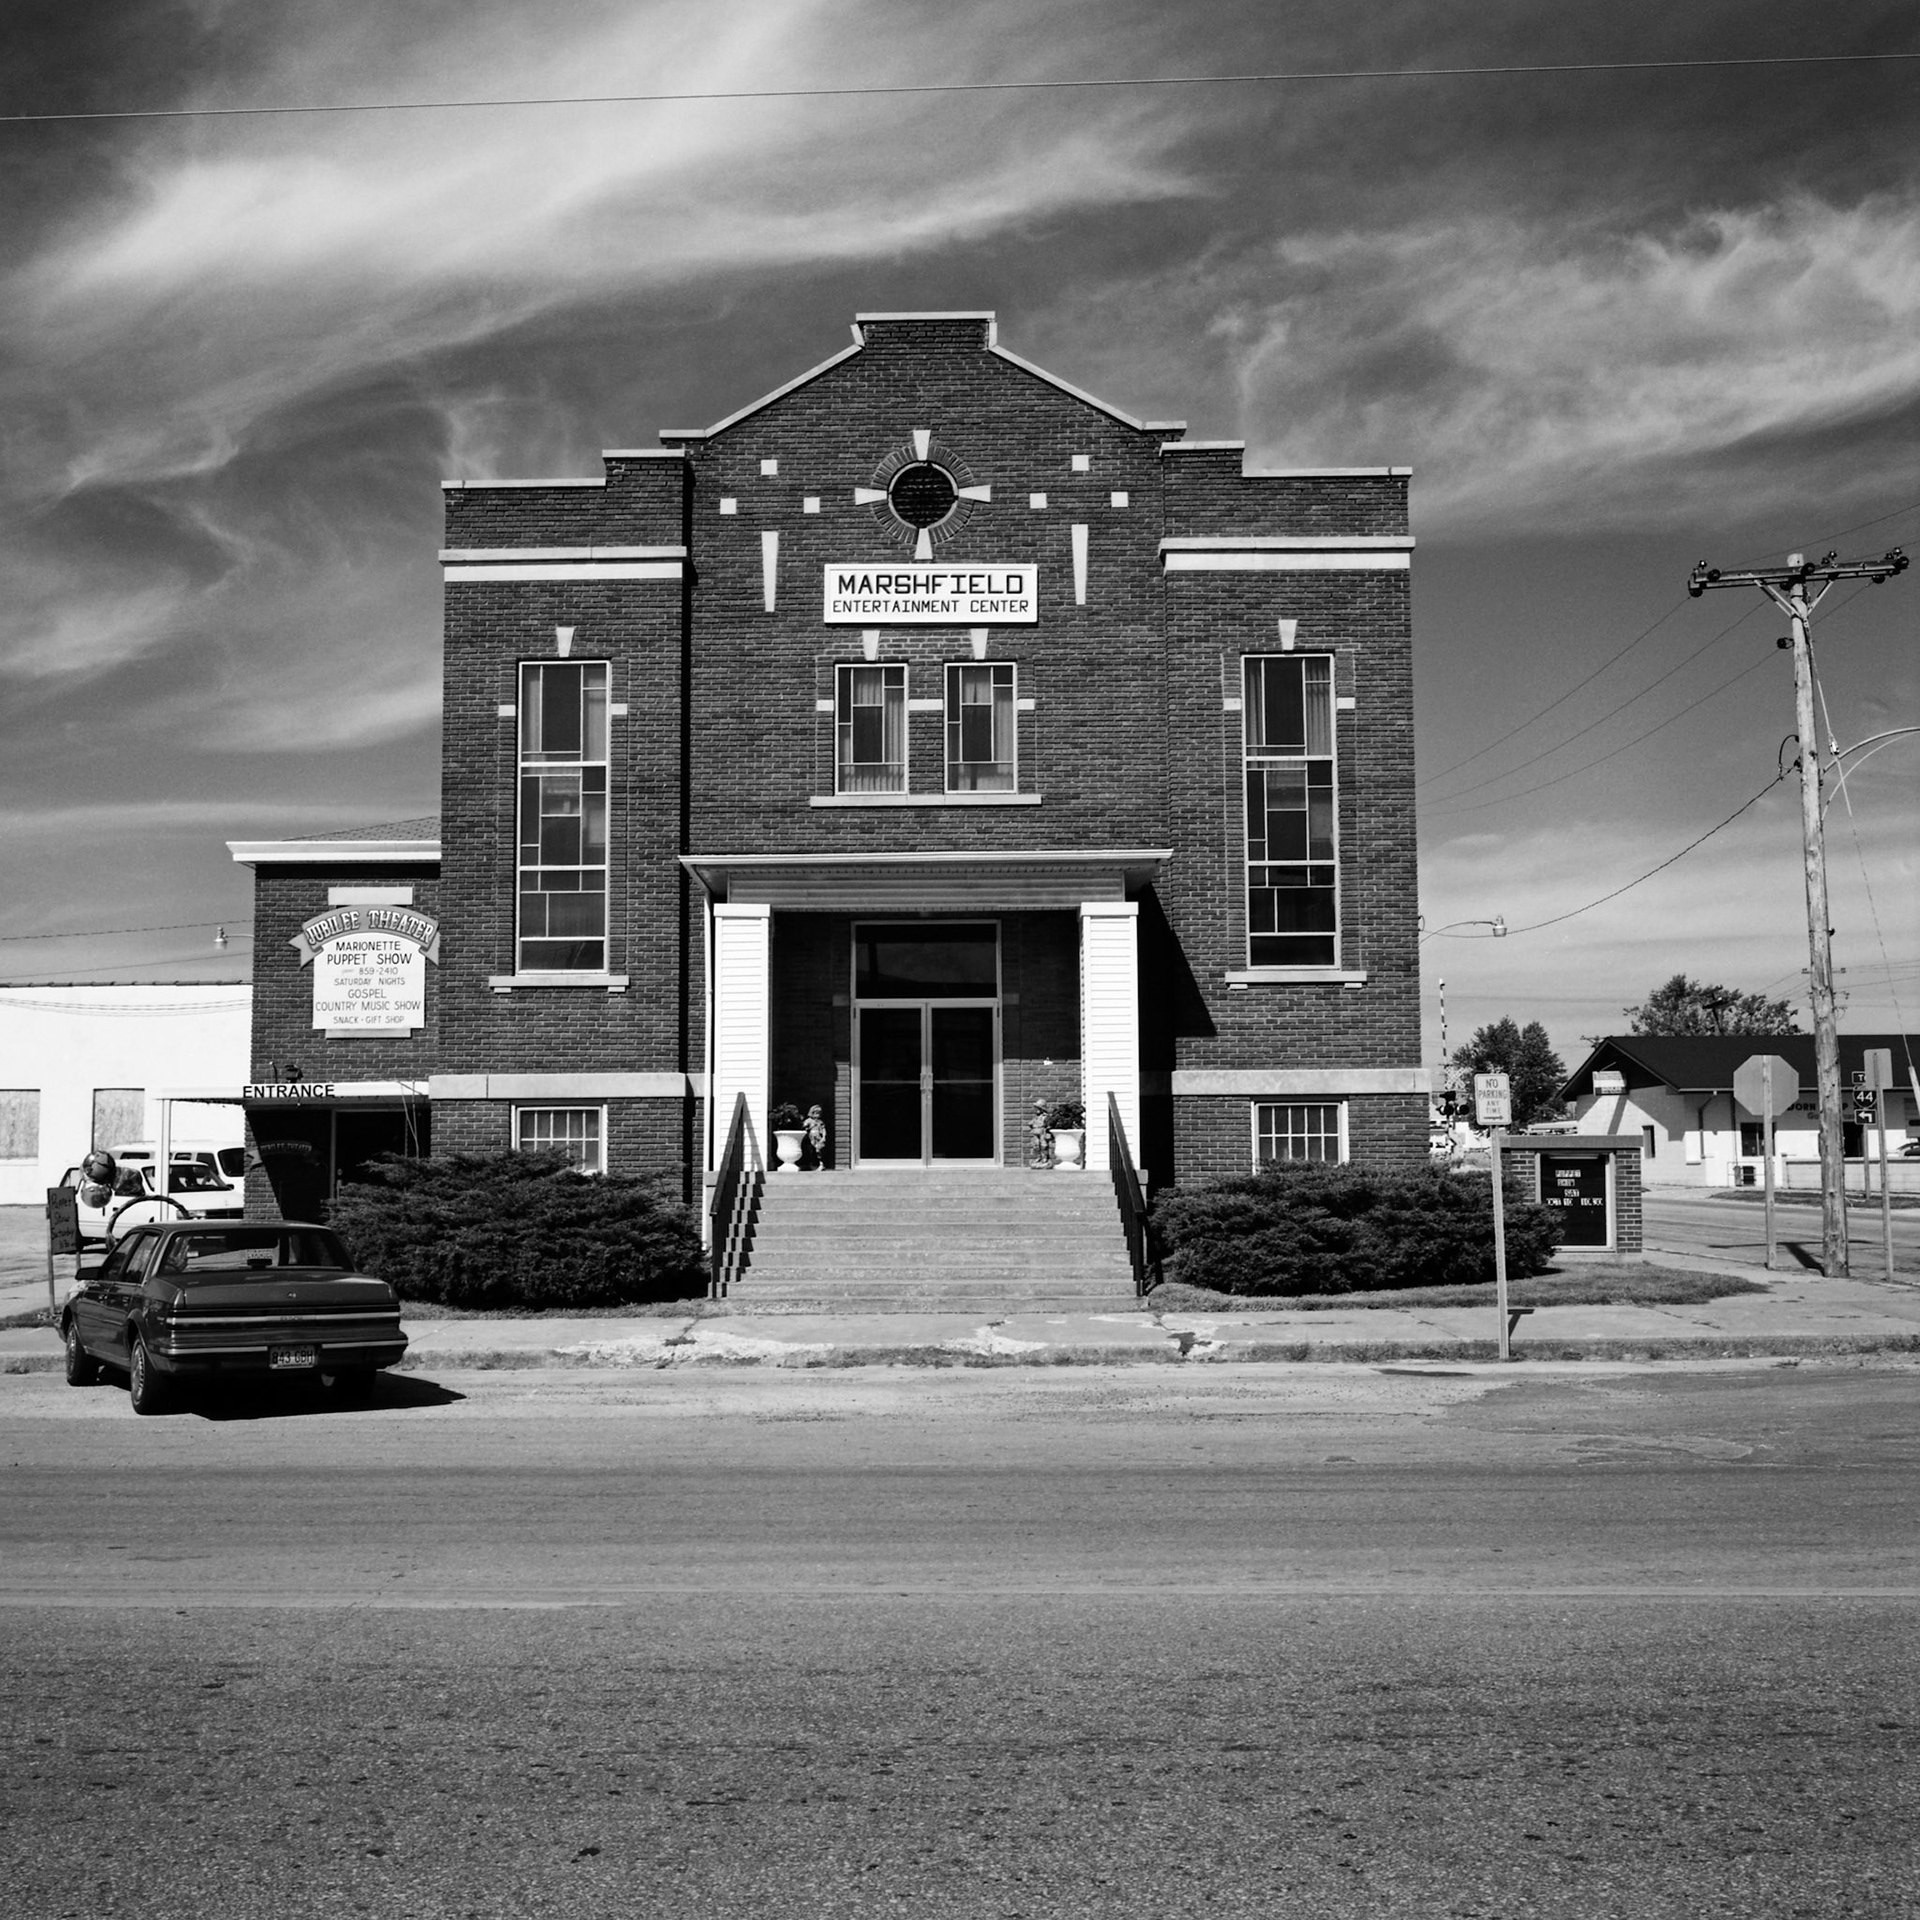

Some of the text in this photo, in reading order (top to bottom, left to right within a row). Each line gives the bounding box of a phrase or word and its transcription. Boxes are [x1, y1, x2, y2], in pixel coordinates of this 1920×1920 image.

[838, 574, 1023, 595] MARSHFIELD
[832, 600, 1029, 613] ENTERTAINMENT CENTER
[305, 909, 435, 946] JUBILEE THEATER
[335, 941, 402, 951] MARIONETTE
[327, 953, 413, 966] PUPPET SHOW
[333, 977, 406, 987] SATURDAY NIGHTS
[347, 988, 387, 999] GOSPEL
[315, 1000, 422, 1012] COUNTRY MUSIC SHOW
[333, 1015, 405, 1025] SNACK GIFT SHOP
[1486, 1079, 1499, 1088] NO
[243, 1084, 335, 1098] ENTRANCE
[1478, 1090, 1508, 1100] PARKING
[1856, 1091, 1874, 1102] 44
